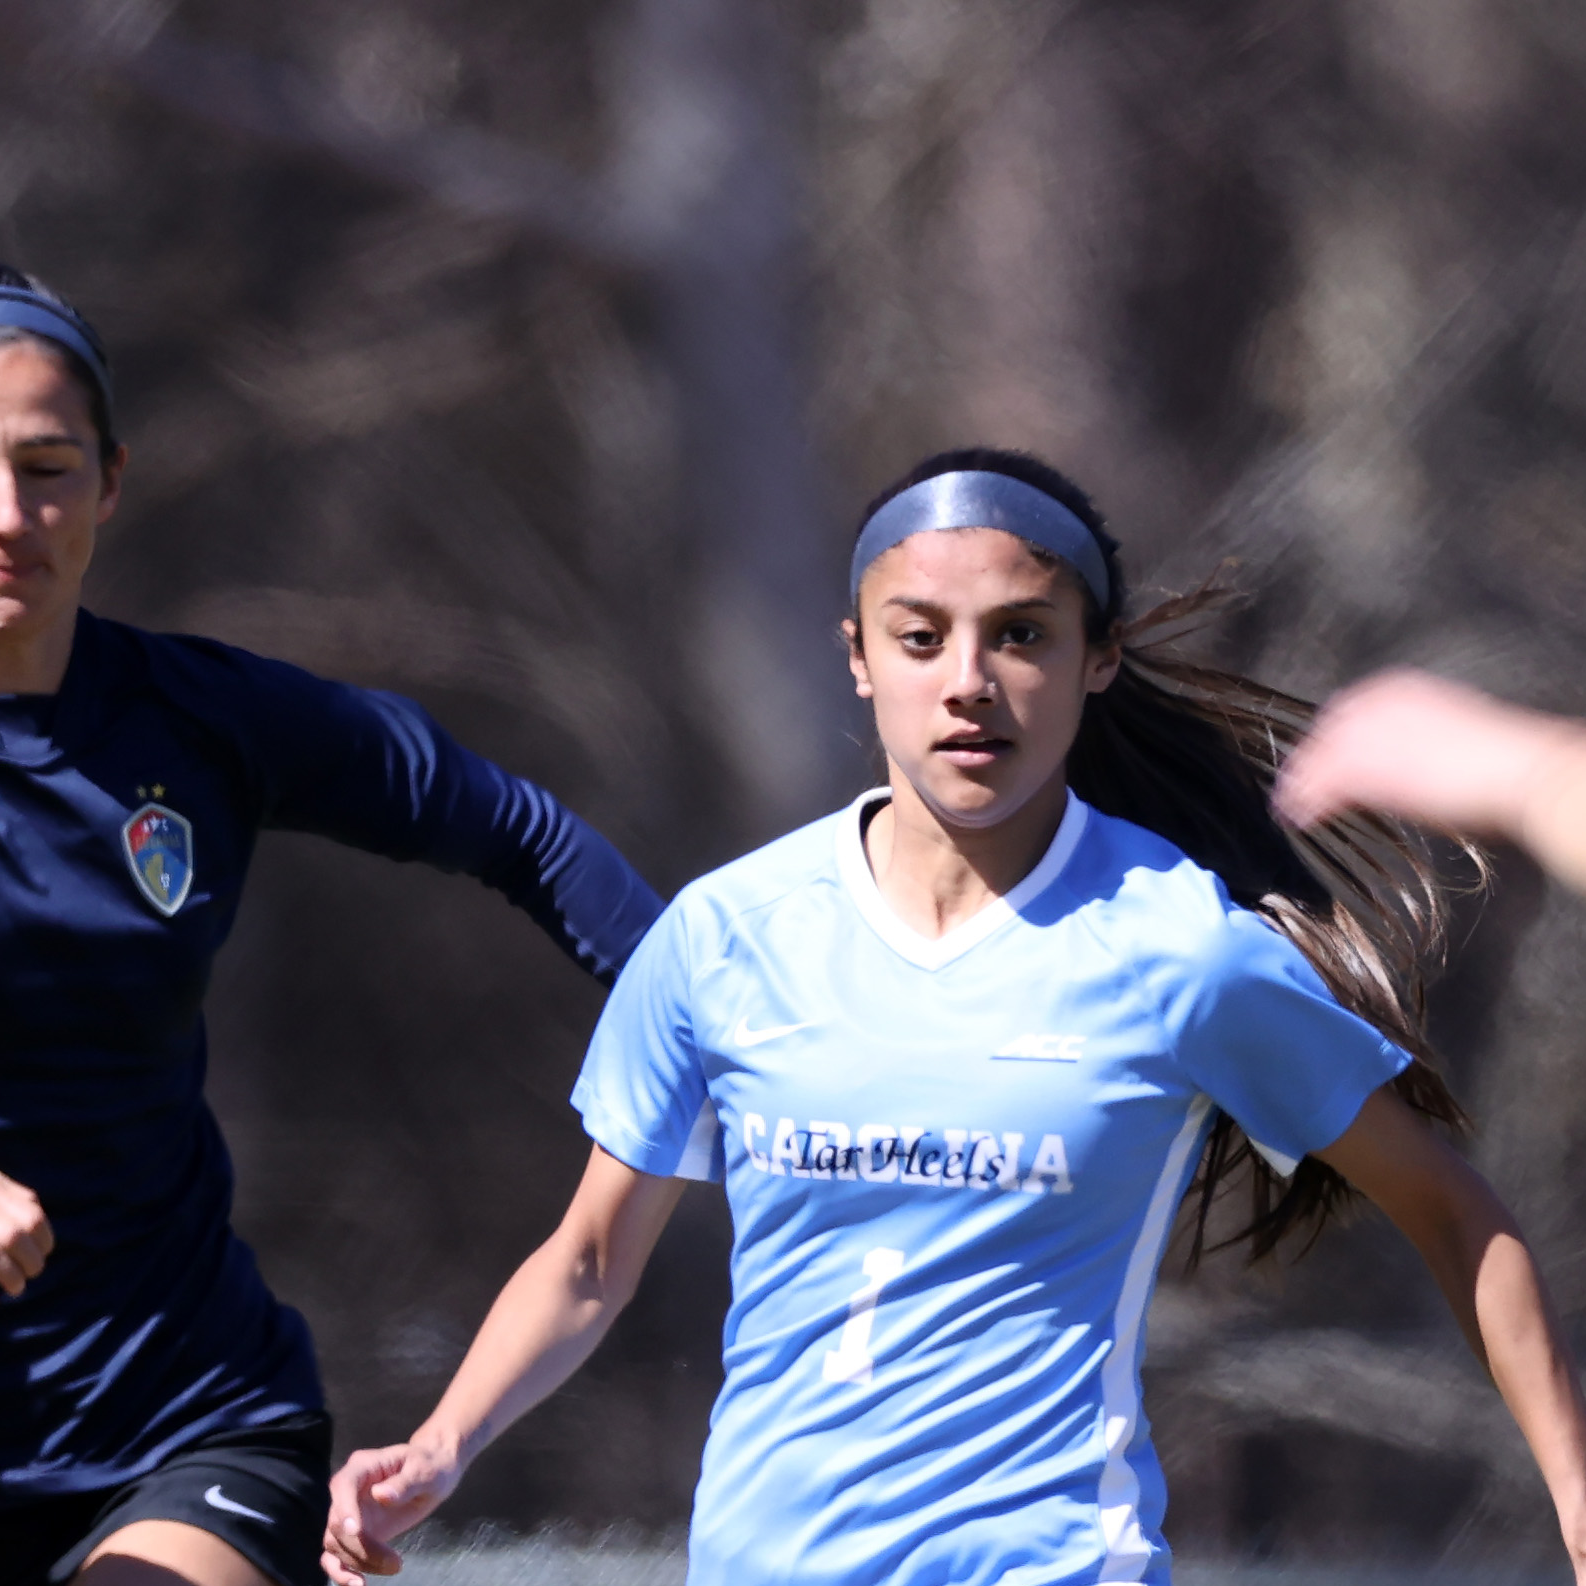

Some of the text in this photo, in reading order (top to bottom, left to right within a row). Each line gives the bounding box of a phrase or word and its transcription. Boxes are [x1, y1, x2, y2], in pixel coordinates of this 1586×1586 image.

[995, 1033, 1088, 1060] ACC
[743, 1111, 1075, 1195] CAROLINA
[785, 1129, 1006, 1182] Tar Heels
[821, 1246, 905, 1386] 1
